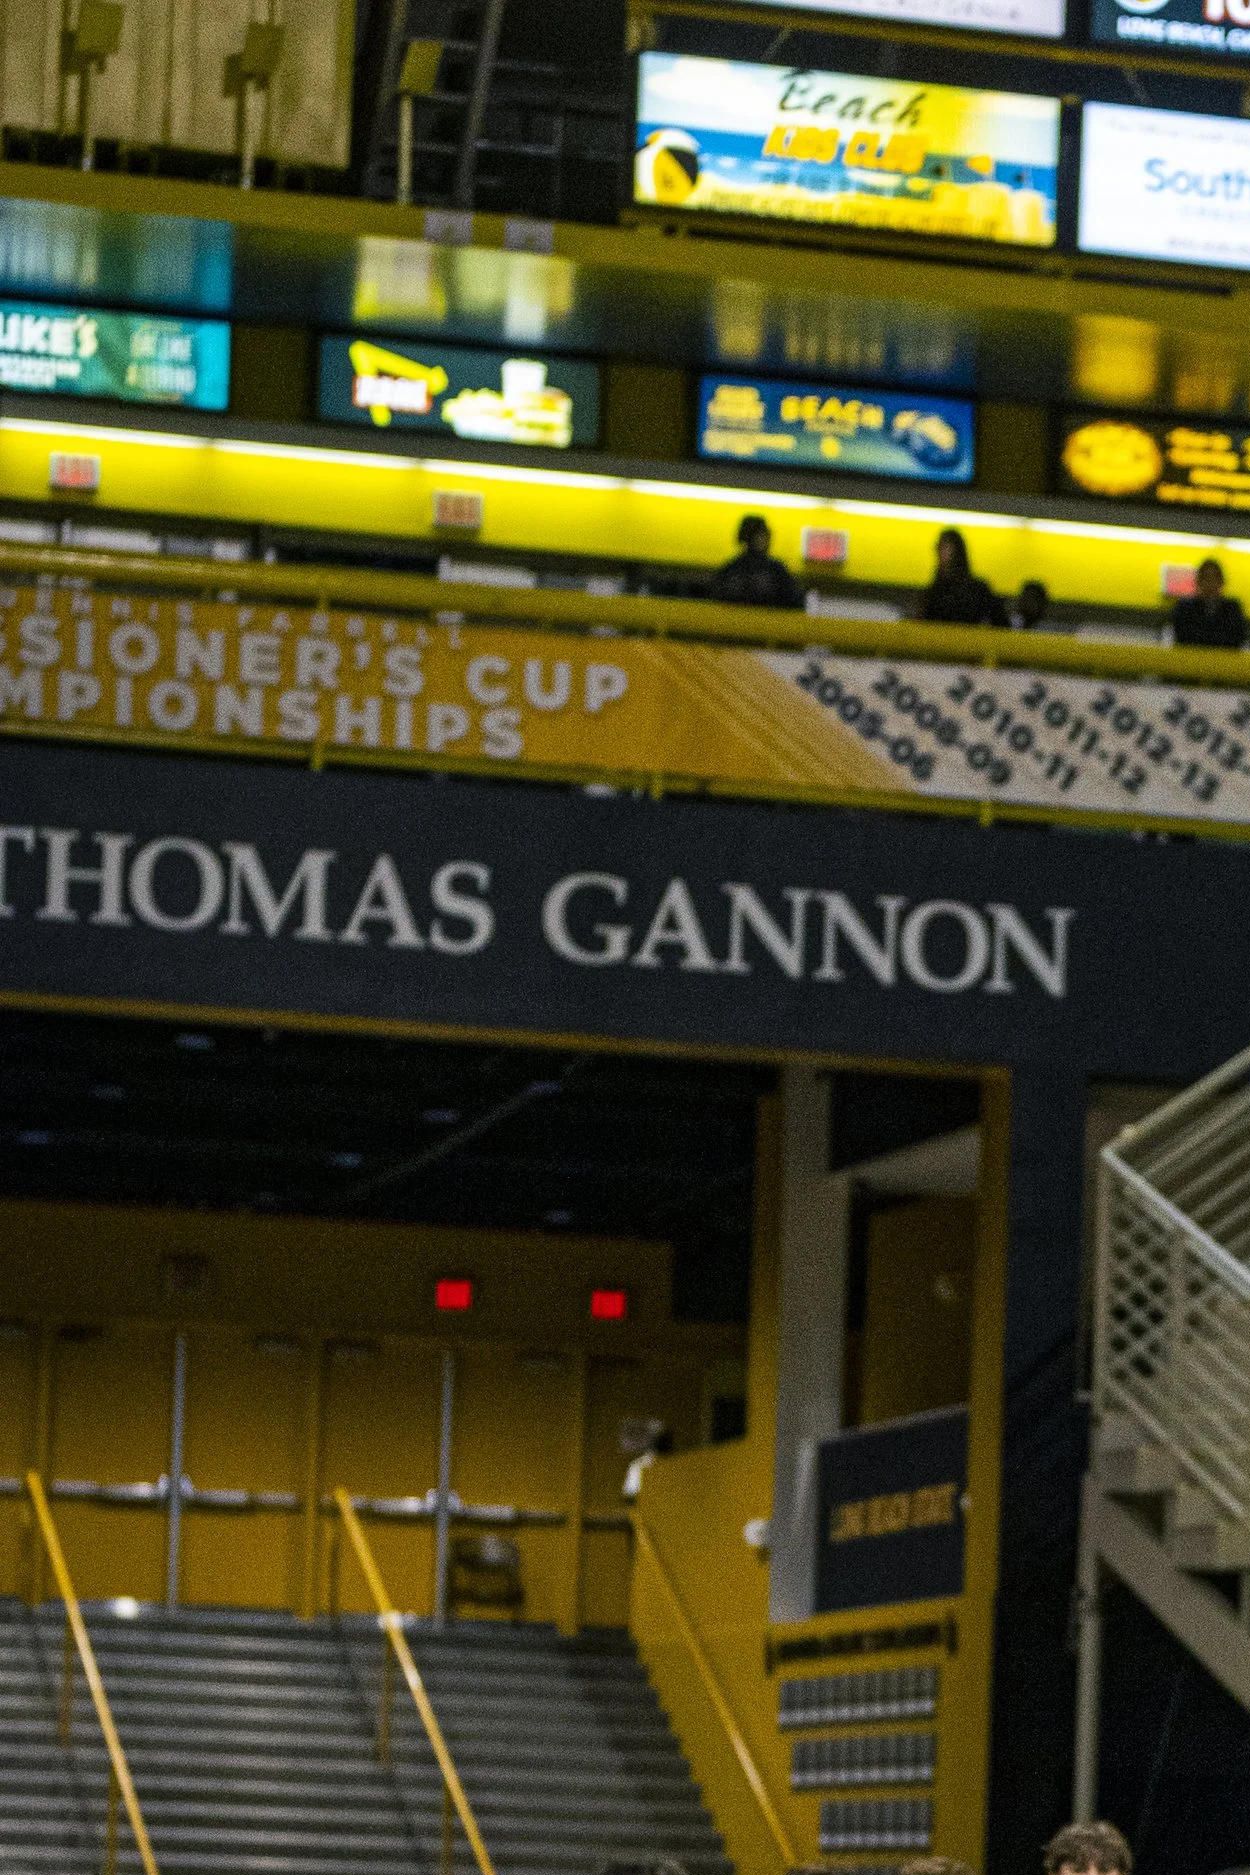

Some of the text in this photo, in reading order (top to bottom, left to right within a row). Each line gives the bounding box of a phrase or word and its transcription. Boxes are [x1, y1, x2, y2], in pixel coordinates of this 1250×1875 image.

[776, 67, 926, 127] Beach
[0, 612, 629, 713] SIONER'S CUP
[947, 673, 1079, 793] 2010-11
[1021, 679, 1148, 797] 2011-12
[540, 870, 1077, 999] GANNON
